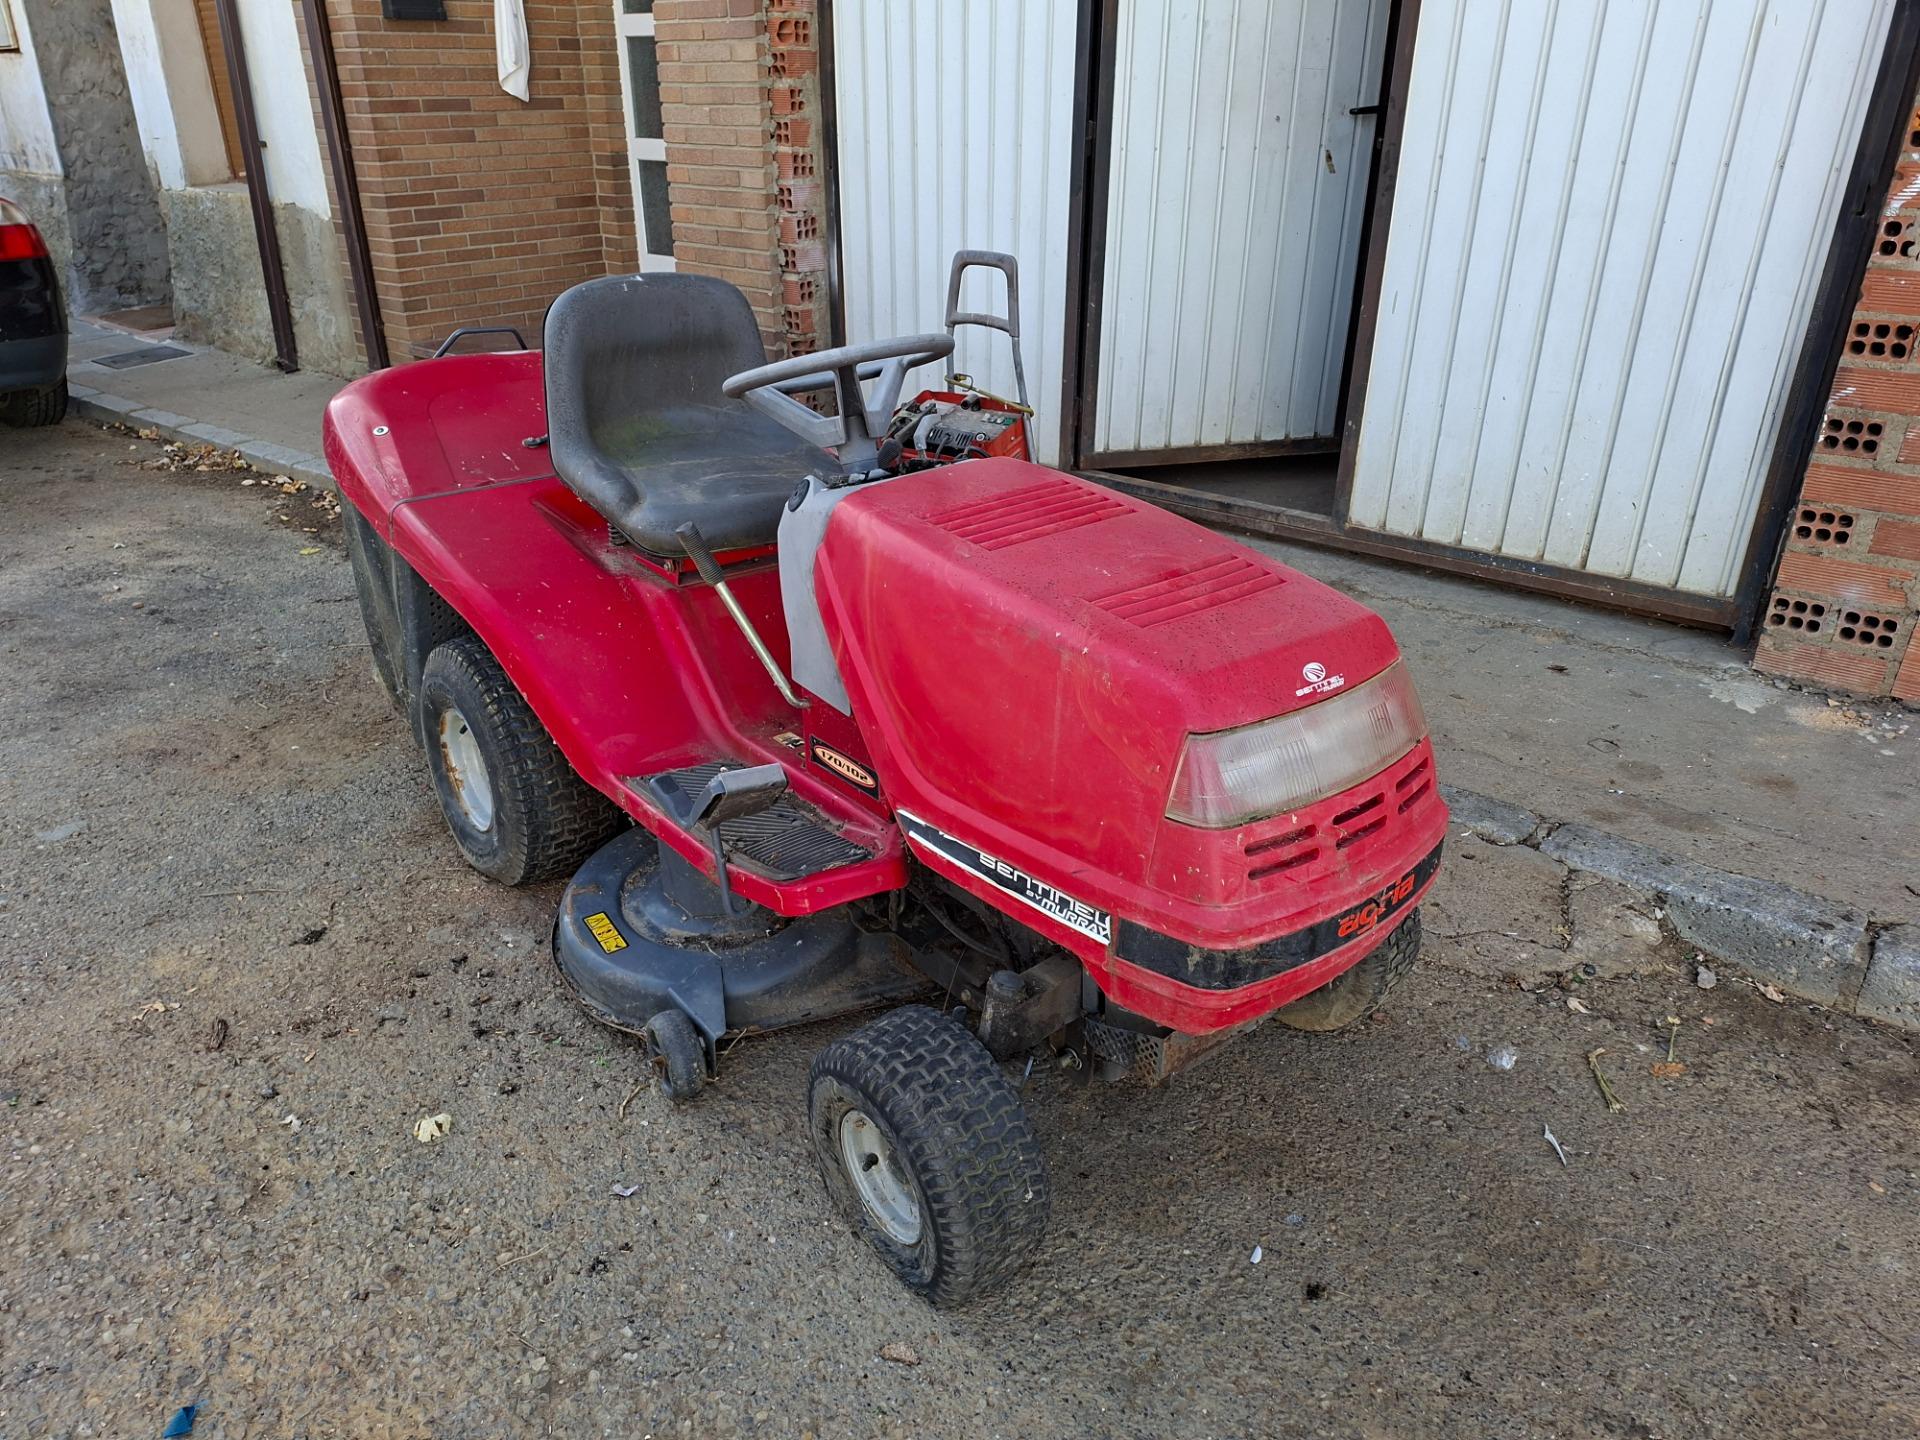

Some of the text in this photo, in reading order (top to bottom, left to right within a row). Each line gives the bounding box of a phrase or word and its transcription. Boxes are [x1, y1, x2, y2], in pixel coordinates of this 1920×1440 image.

[979, 852, 1108, 929] SENTINEL
[1026, 890, 1110, 937] BY MURRAY
